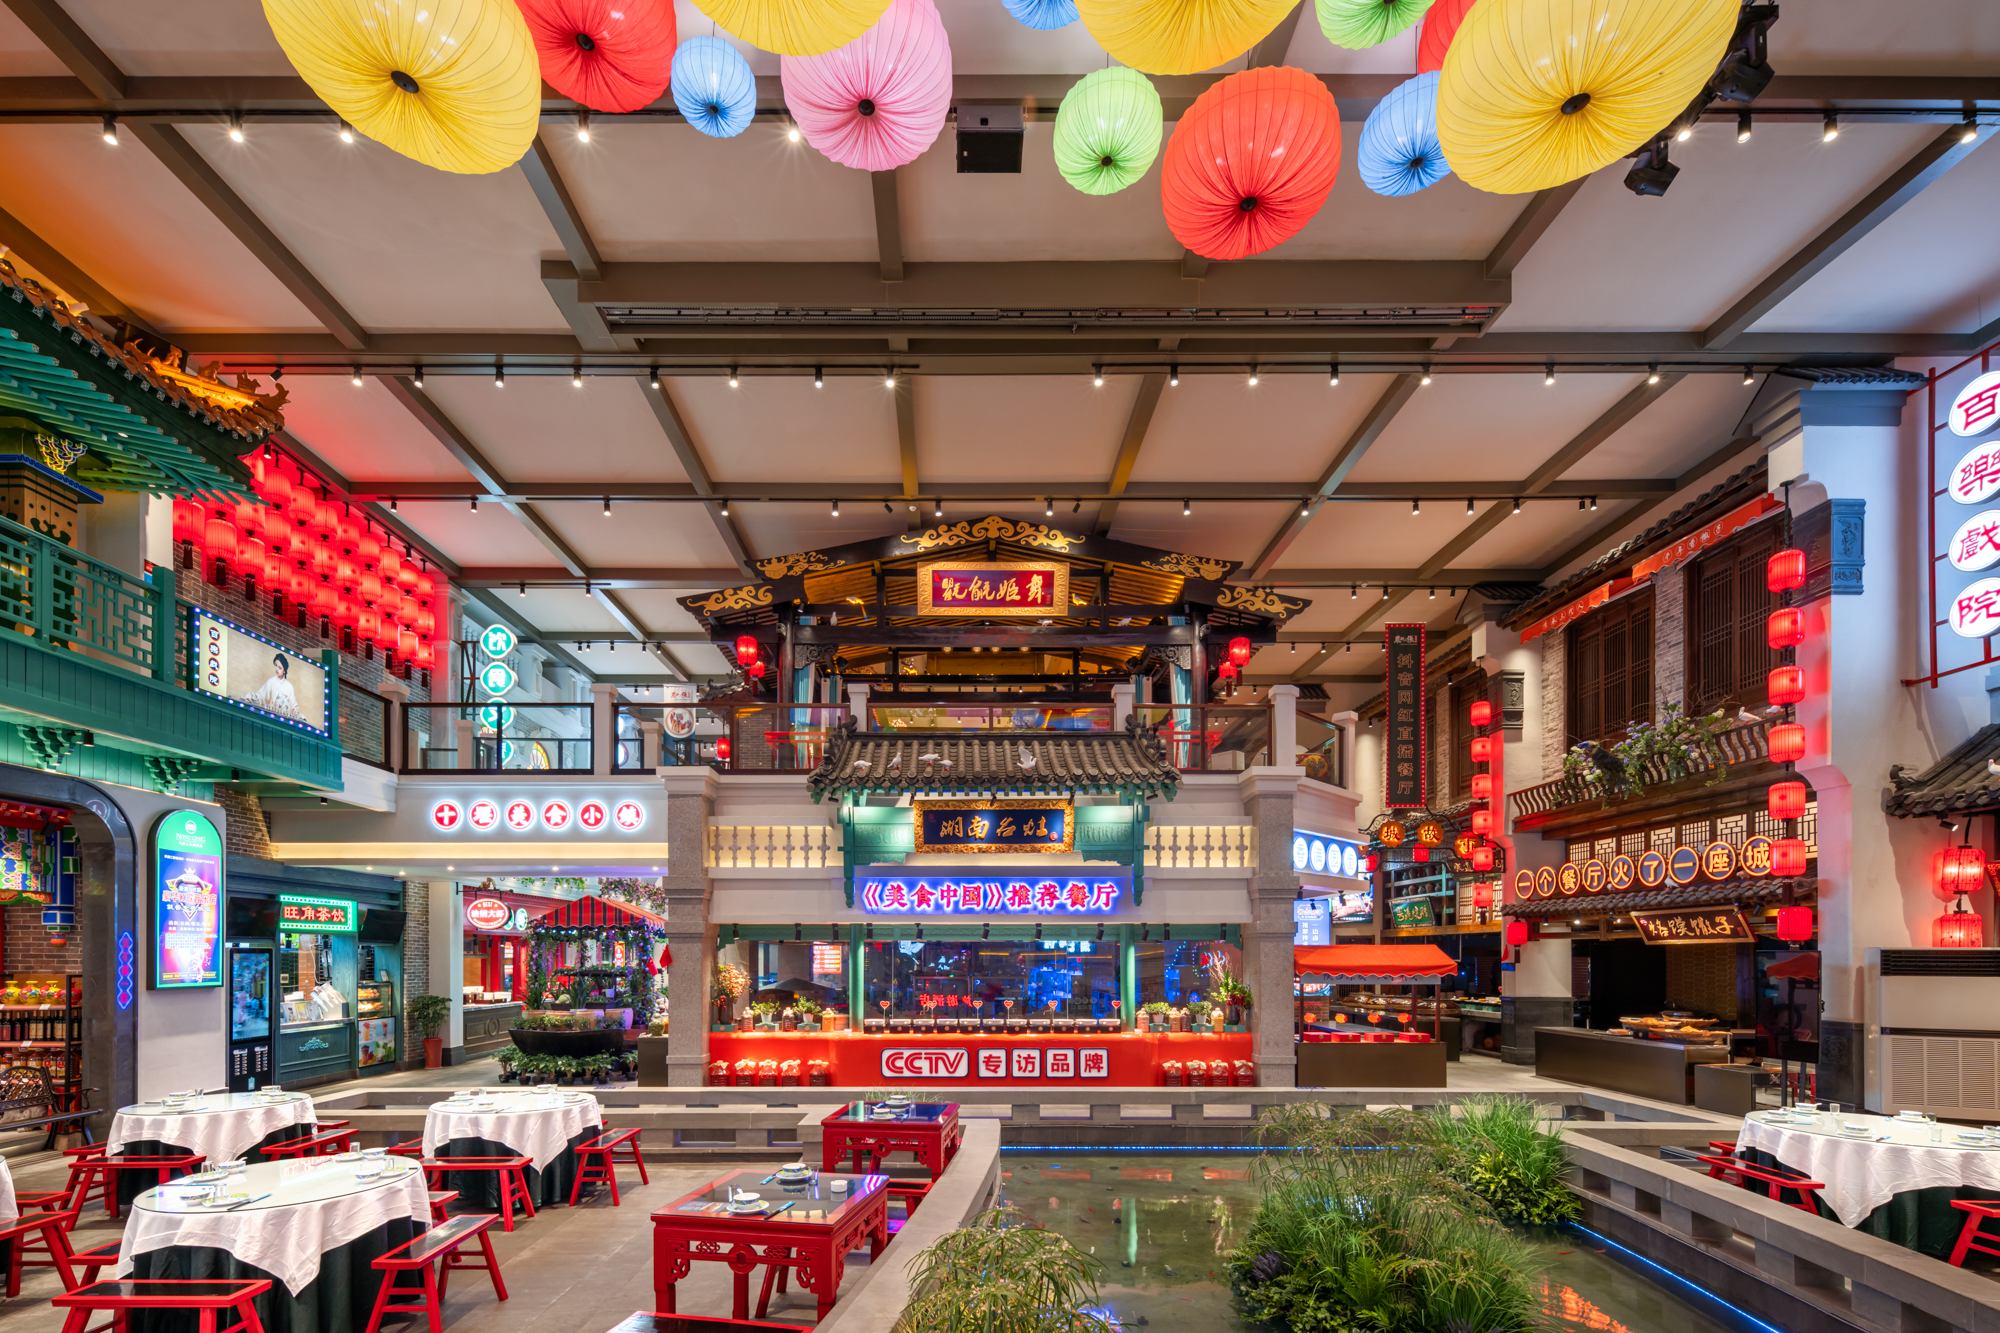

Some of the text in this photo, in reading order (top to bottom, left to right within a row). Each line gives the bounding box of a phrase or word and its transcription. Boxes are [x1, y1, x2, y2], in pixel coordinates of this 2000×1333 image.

[1397, 653, 1414, 795] 抖音网红直播餐厅
[437, 803, 640, 828] 十堰美食小镇
[1518, 842, 1770, 892] 一个餐厅火了一座城
[863, 882, 1119, 910] 《美食中国》推荐餐厅
[283, 905, 346, 923] 旺角茶饮
[885, 1051, 1105, 1074] CCTV 专访品牌
